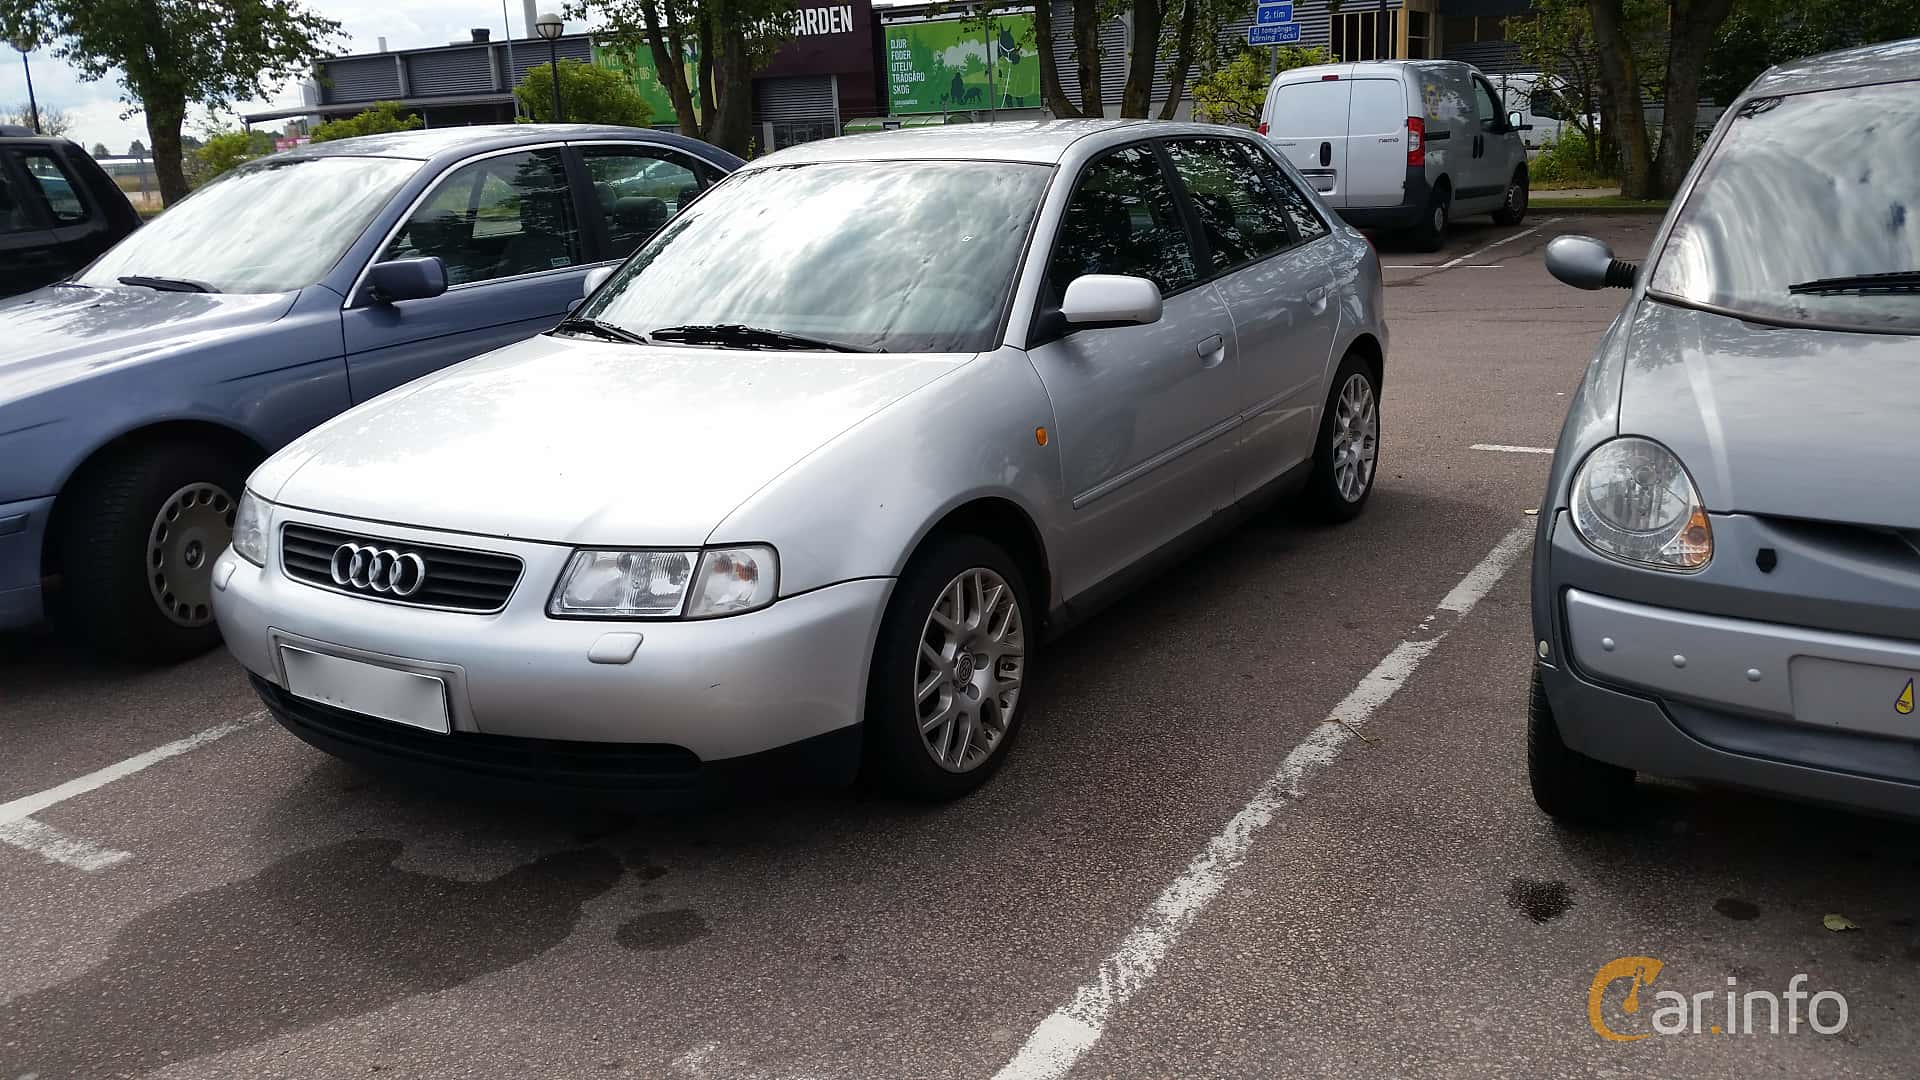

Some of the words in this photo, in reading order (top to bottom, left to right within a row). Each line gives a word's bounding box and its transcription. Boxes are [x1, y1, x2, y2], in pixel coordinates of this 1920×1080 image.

[1273, 10, 1286, 18] tim
[891, 39, 906, 48] DJUR
[892, 50, 911, 60] FODER
[892, 61, 912, 71] UTELIV
[893, 85, 910, 94] SKOG
